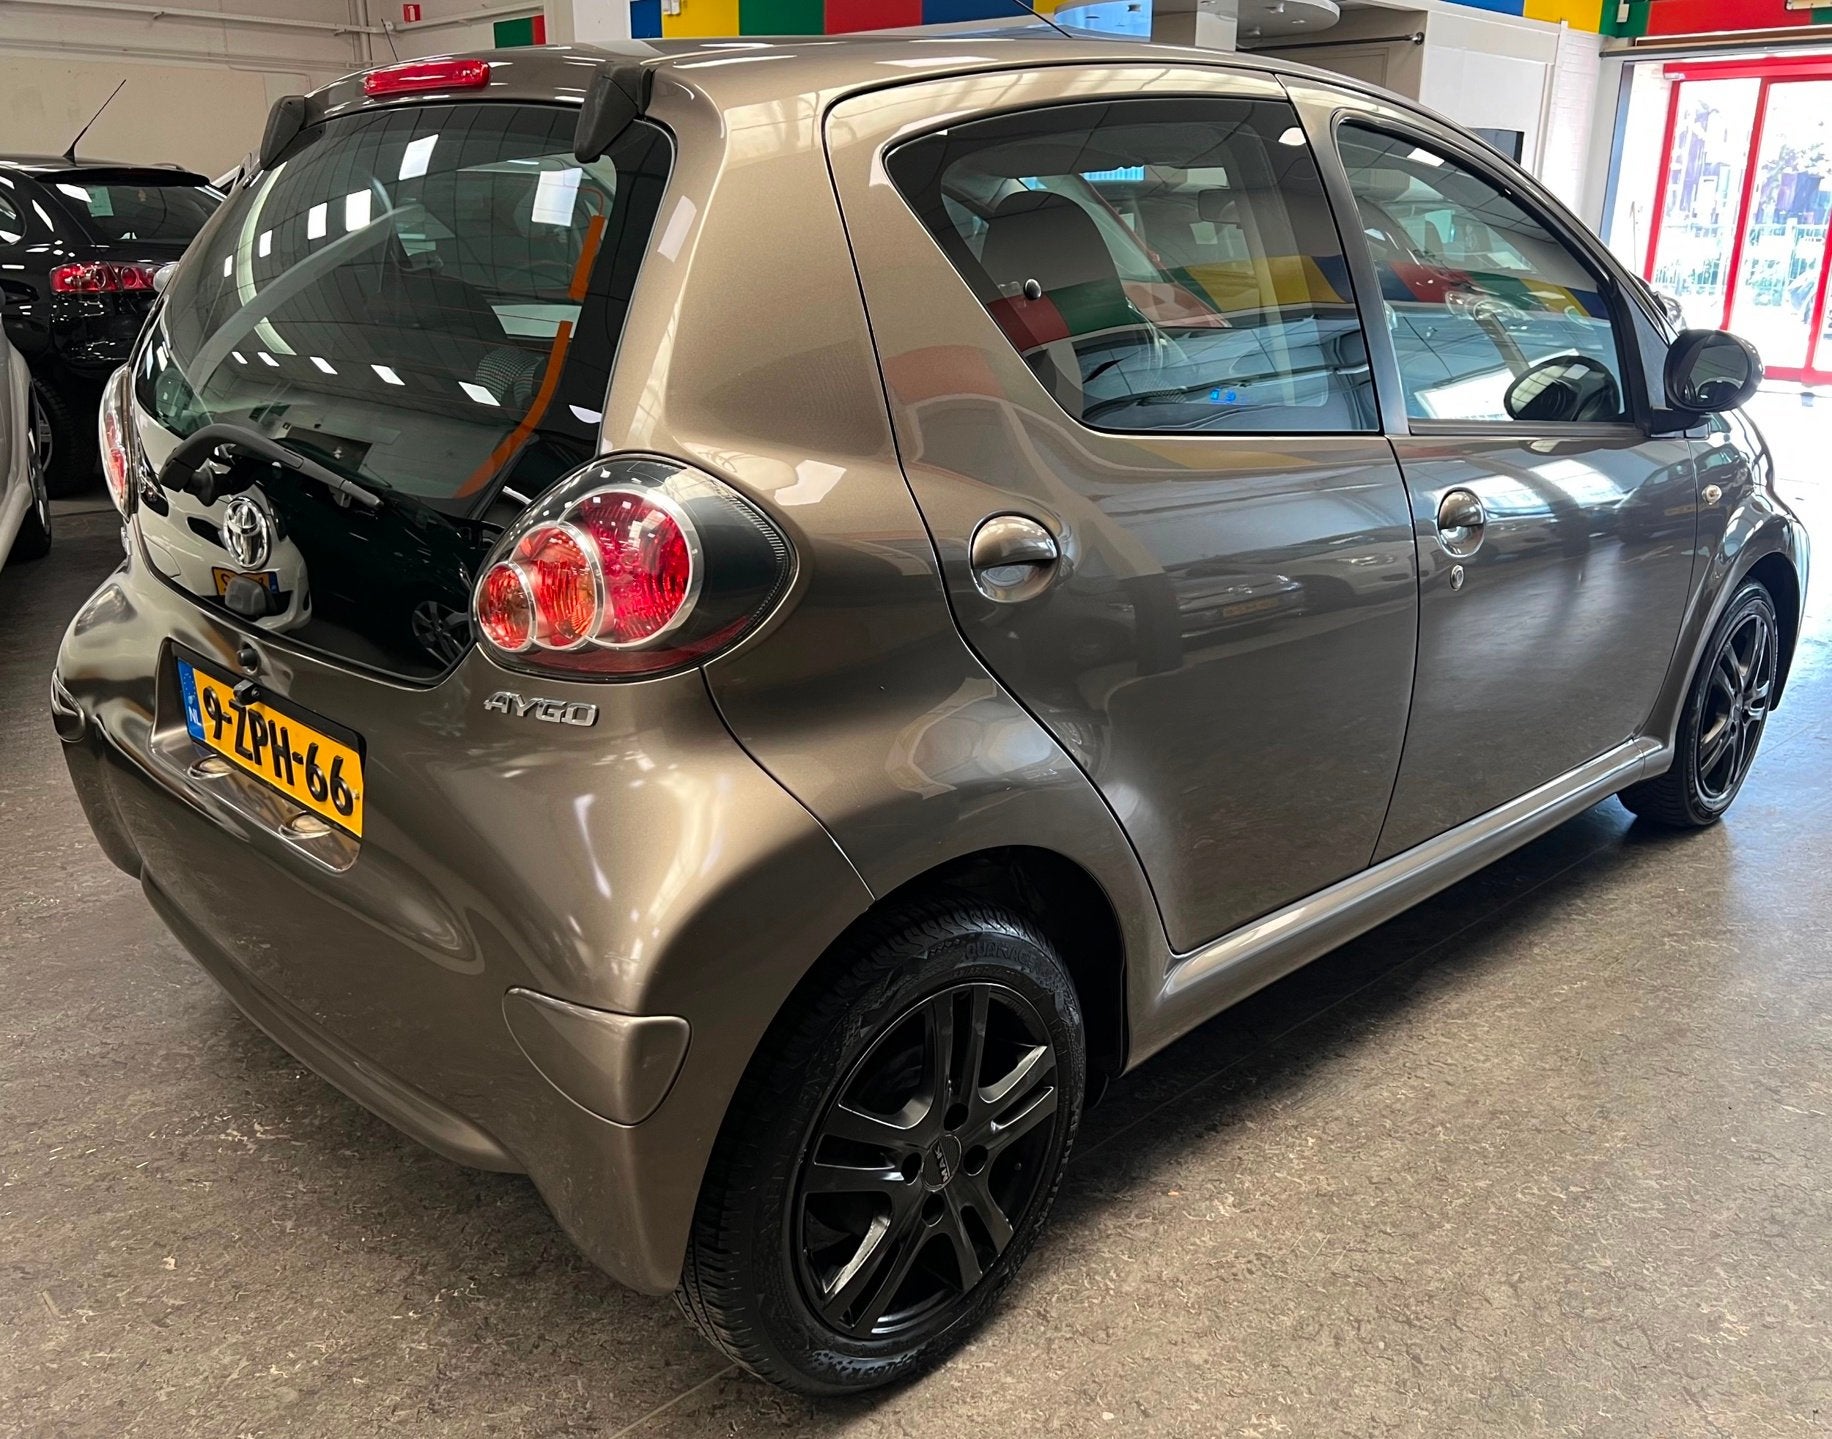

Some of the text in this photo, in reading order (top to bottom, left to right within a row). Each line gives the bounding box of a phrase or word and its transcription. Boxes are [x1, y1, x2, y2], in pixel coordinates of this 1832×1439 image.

[188, 706, 202, 726] NL
[483, 691, 597, 727] AYGO
[202, 685, 354, 817] 9-ZPH-66
[932, 1144, 949, 1183] MAK
